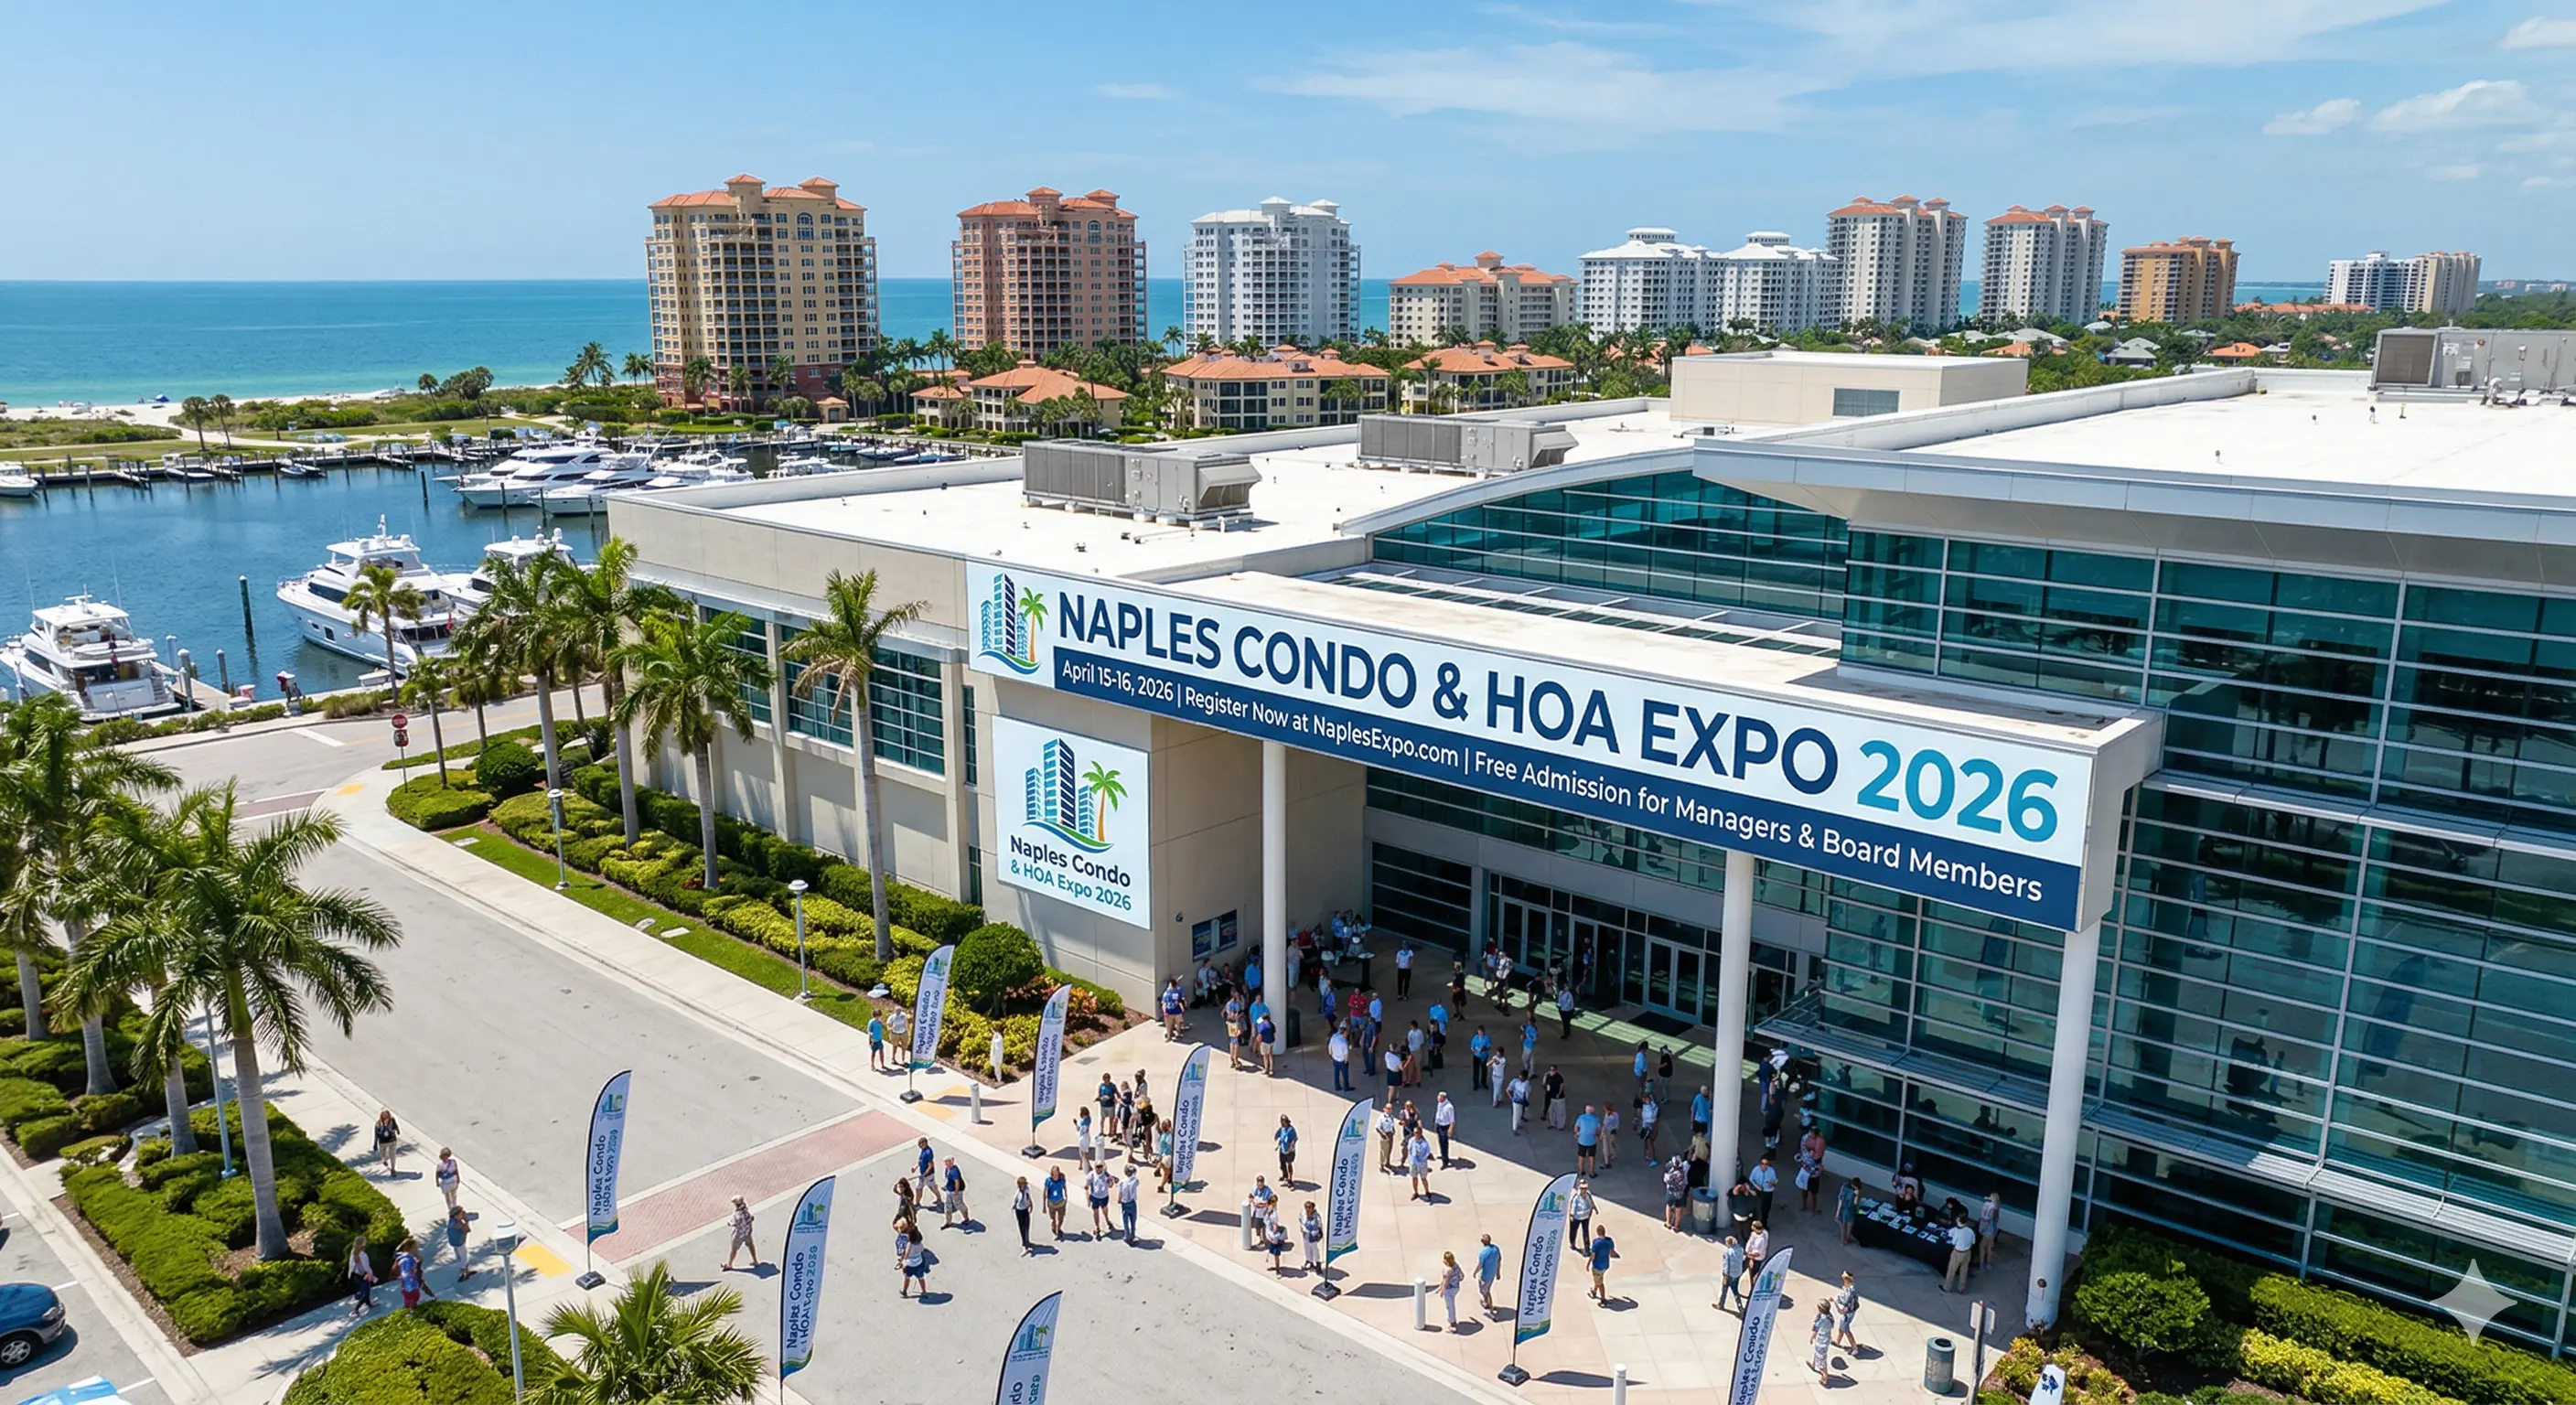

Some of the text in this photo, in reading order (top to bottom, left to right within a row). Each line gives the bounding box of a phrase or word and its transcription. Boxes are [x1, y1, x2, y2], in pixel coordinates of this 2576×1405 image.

[1059, 591, 2058, 843] NAPLES CONDO & HOA EXPO 2026
[1062, 660, 1096, 684] April
[1097, 666, 1136, 696] 15-16,
[1137, 675, 1174, 702] 2026
[1186, 686, 1249, 718] Register
[1252, 701, 1289, 727] Now
[1293, 713, 1309, 733] at
[1314, 714, 1458, 767] NaplesExpo.com
[1475, 751, 1518, 780] Free
[1521, 762, 1631, 807] Admission
[1637, 785, 1669, 814] for
[1676, 795, 1791, 843] Managers
[1798, 823, 1815, 849] &
[1823, 828, 1901, 869] Board
[1909, 847, 2043, 902] Members
[1010, 834, 1132, 888] Naples Condo
[1010, 858, 1132, 911] & HOA Expo 2026
